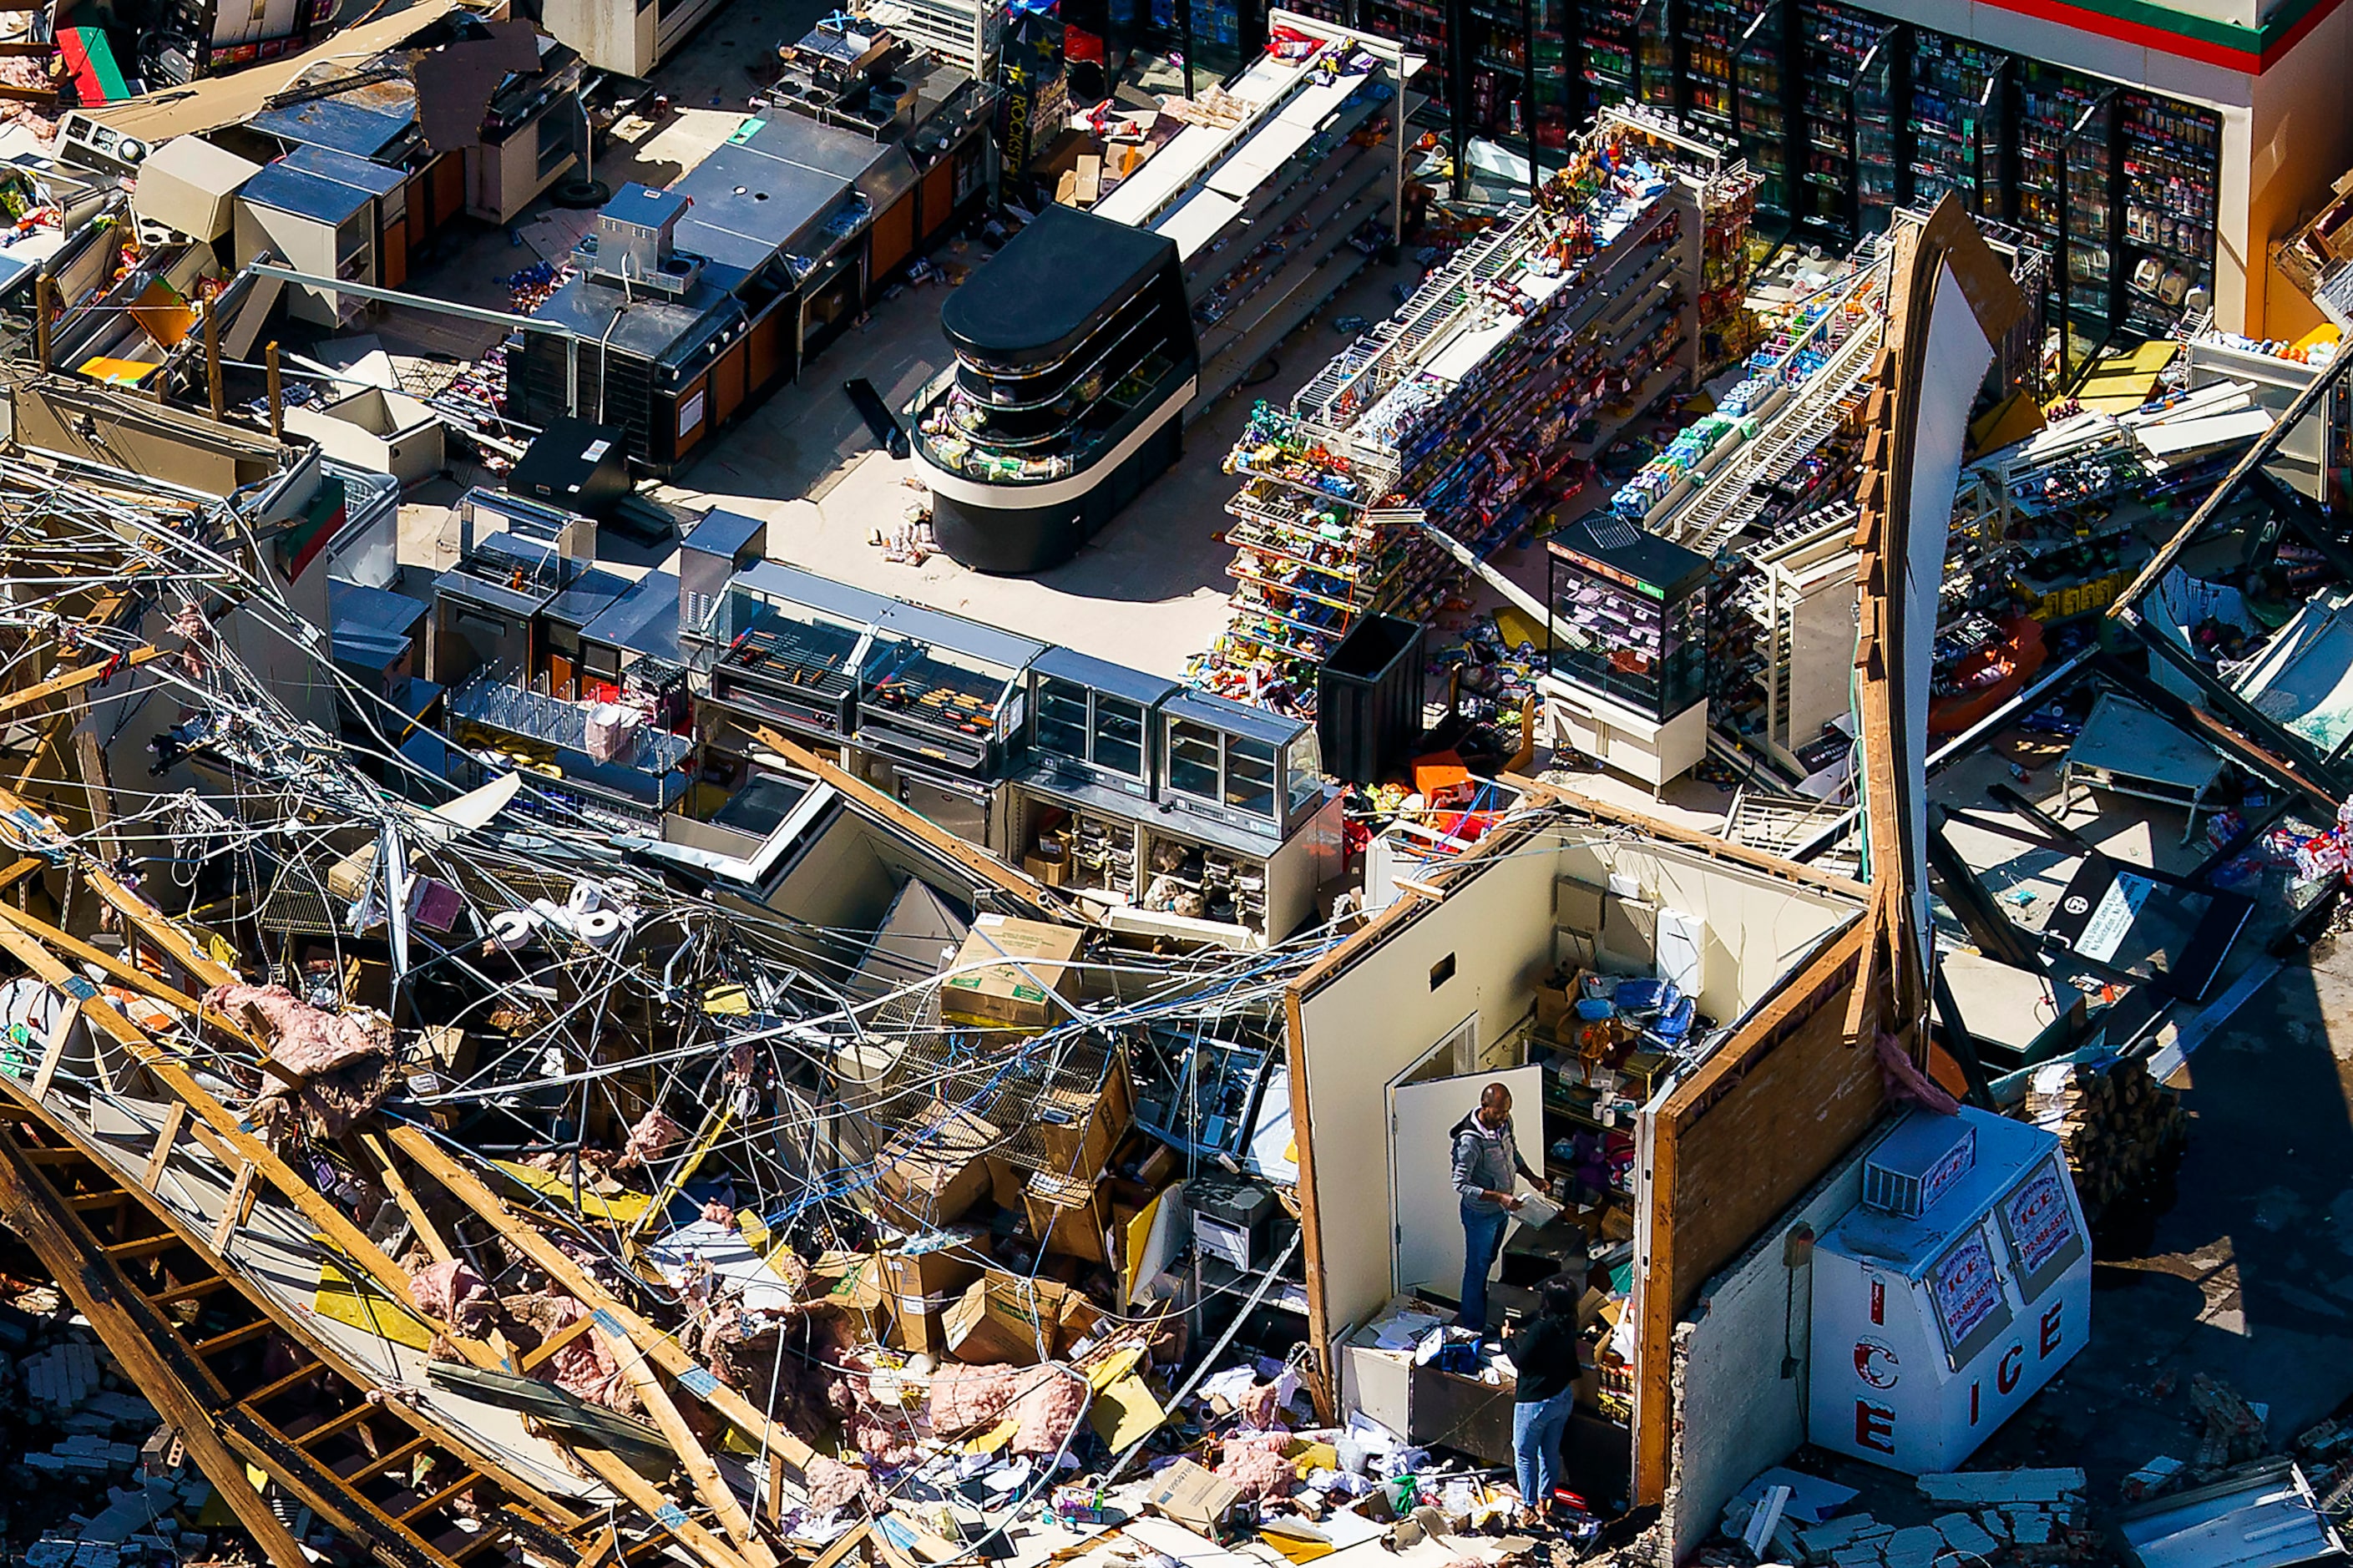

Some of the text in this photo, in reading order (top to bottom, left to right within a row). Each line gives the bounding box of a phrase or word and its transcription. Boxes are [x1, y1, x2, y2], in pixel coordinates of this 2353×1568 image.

[1004, 94, 1026, 181] ROCKST
[2021, 1187, 2053, 1225] ICE
[1948, 1255, 1979, 1293] ICE
[1853, 1273, 1900, 1455] ICE
[1969, 1296, 2063, 1427] ICE
